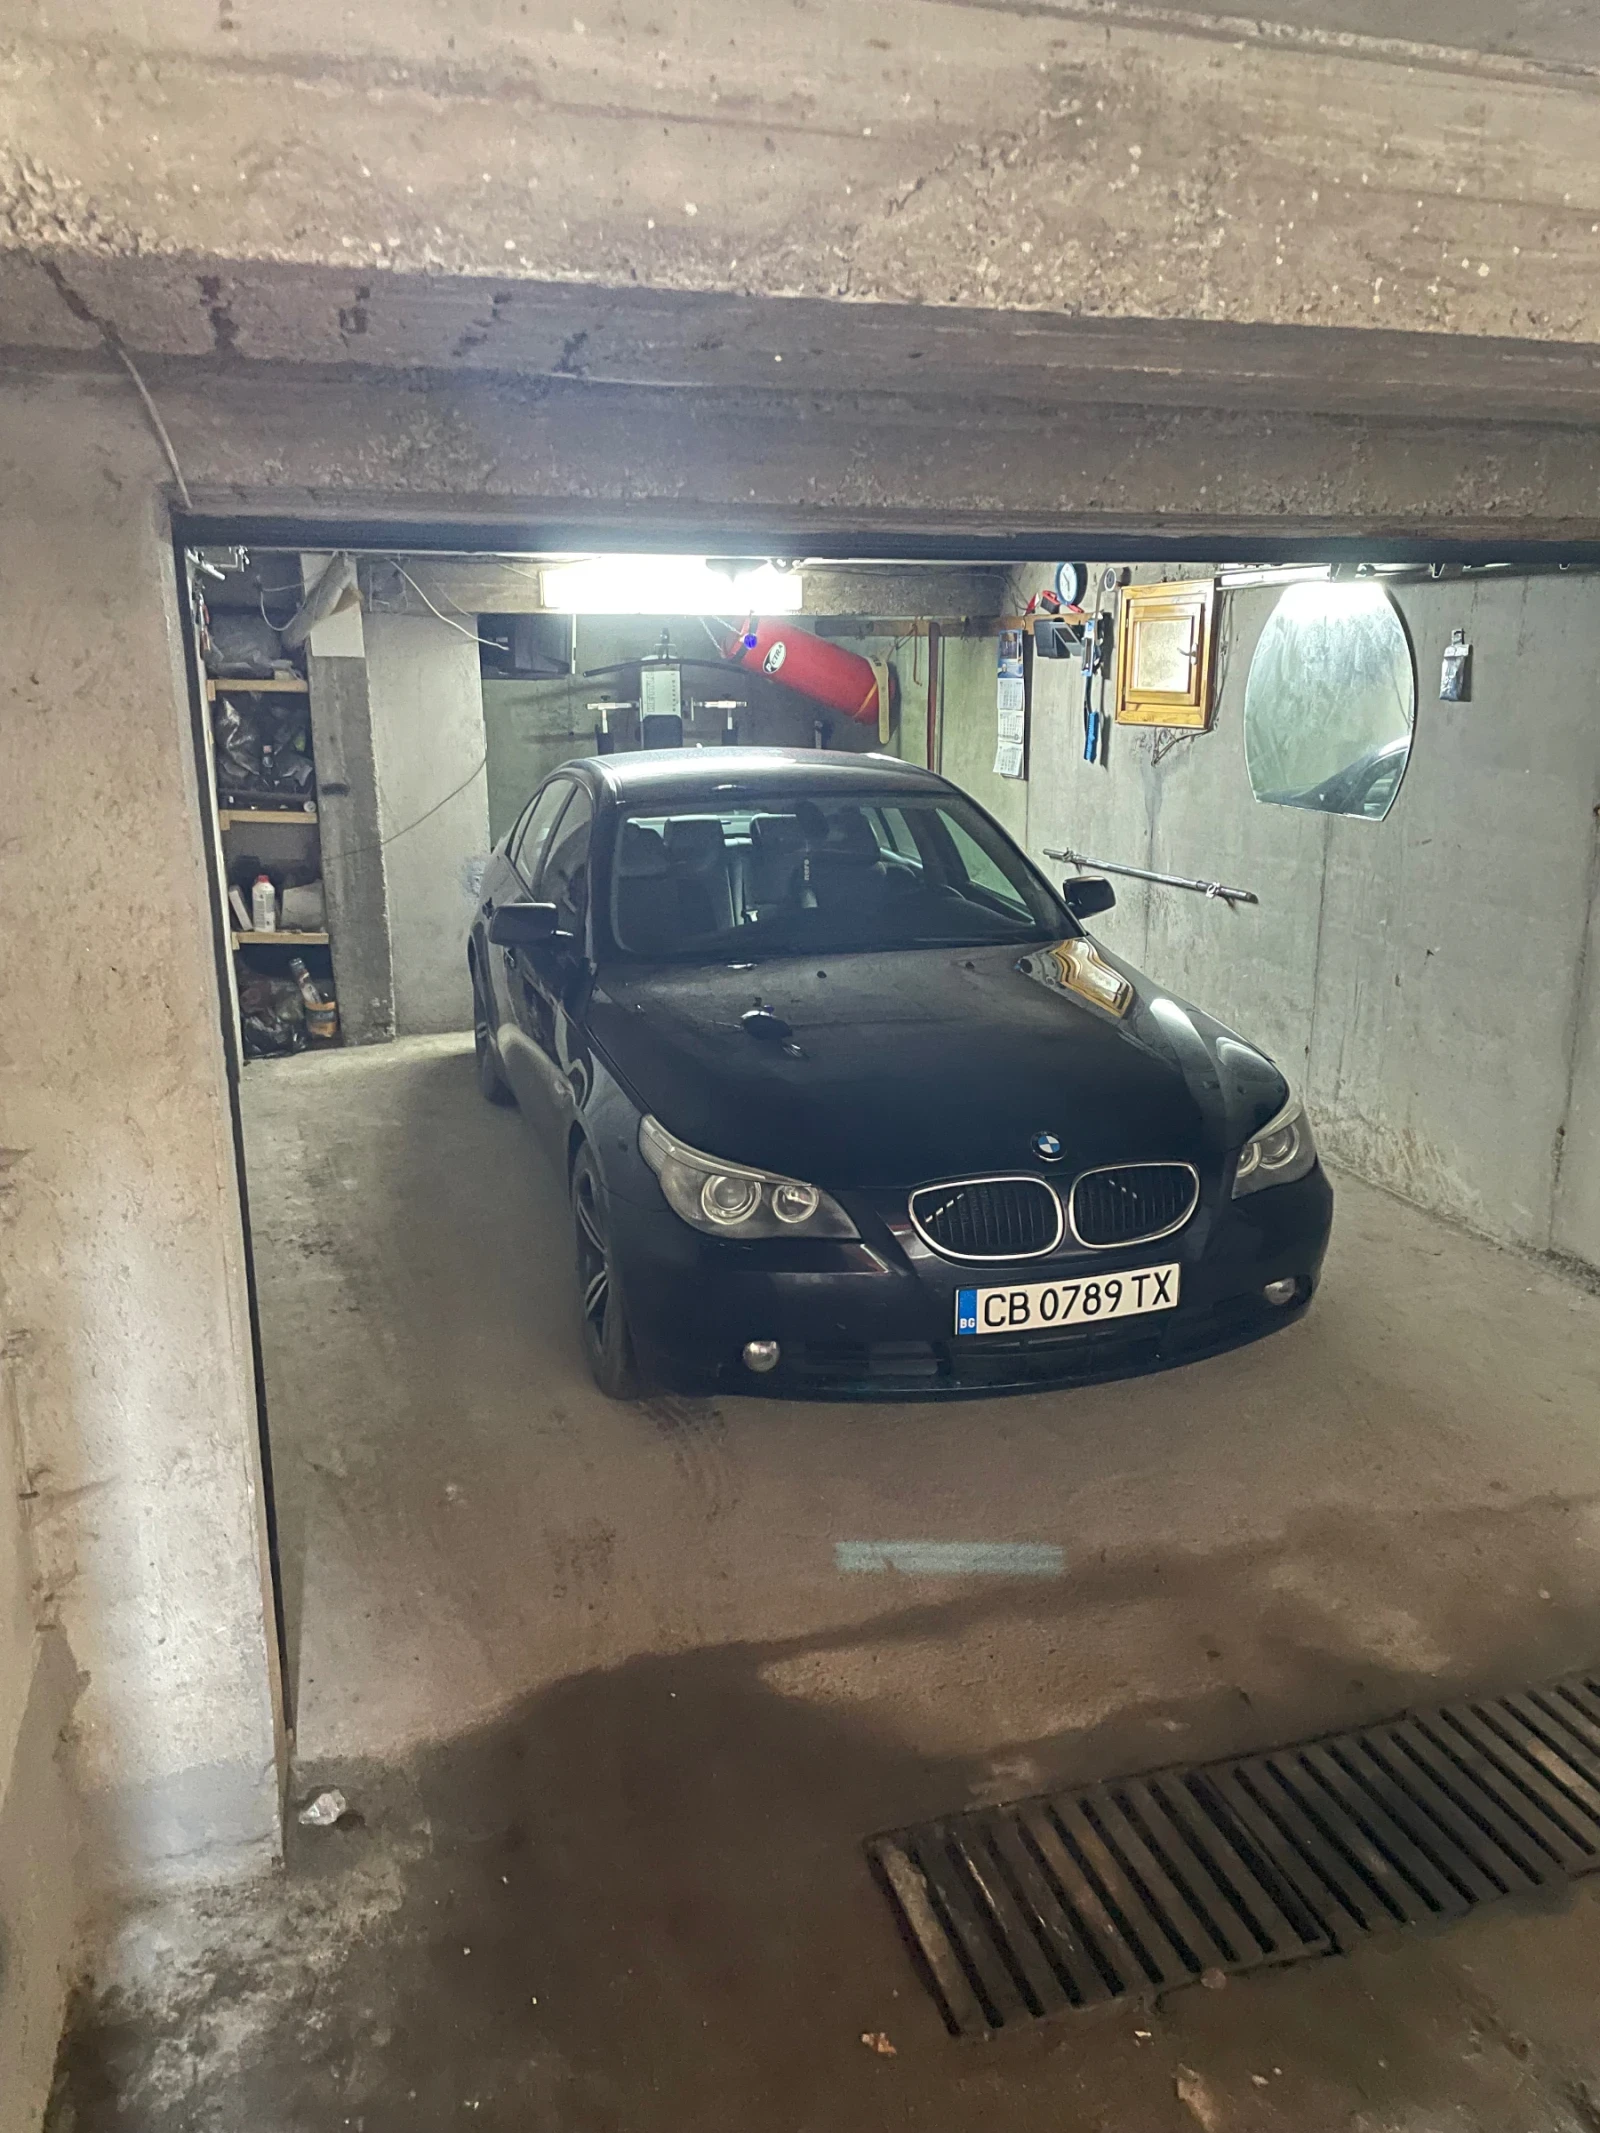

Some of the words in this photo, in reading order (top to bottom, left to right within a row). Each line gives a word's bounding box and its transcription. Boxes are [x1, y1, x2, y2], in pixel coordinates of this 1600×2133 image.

[984, 1291, 1030, 1327] CB
[1040, 1279, 1123, 1321] 0789
[1131, 1269, 1172, 1308] TX
[959, 1317, 976, 1329] BG
